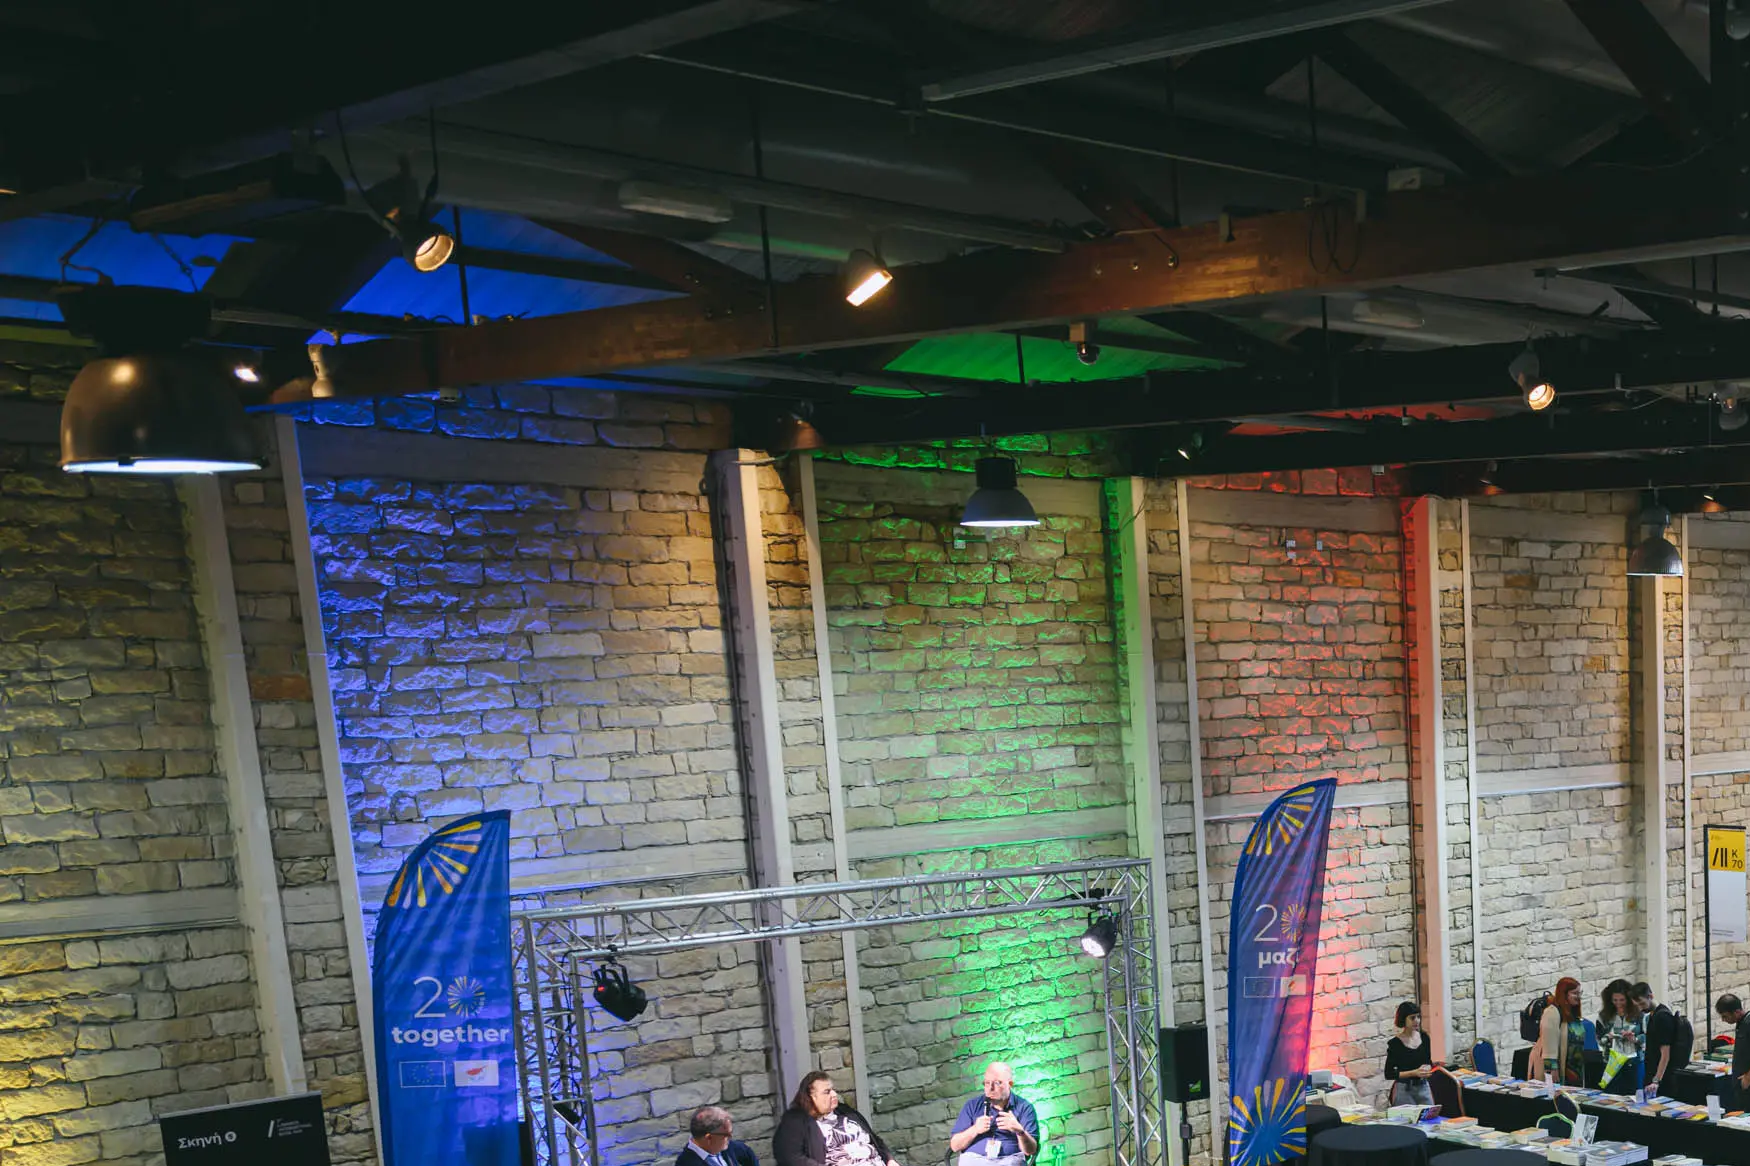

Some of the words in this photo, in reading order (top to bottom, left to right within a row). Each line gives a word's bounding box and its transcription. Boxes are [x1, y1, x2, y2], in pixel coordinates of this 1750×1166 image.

[1731, 849, 1738, 857] K
[1731, 859, 1744, 868] 70
[413, 976, 486, 1018] 20
[392, 1024, 510, 1047] together
[177, 1131, 222, 1149] Σκηνή
